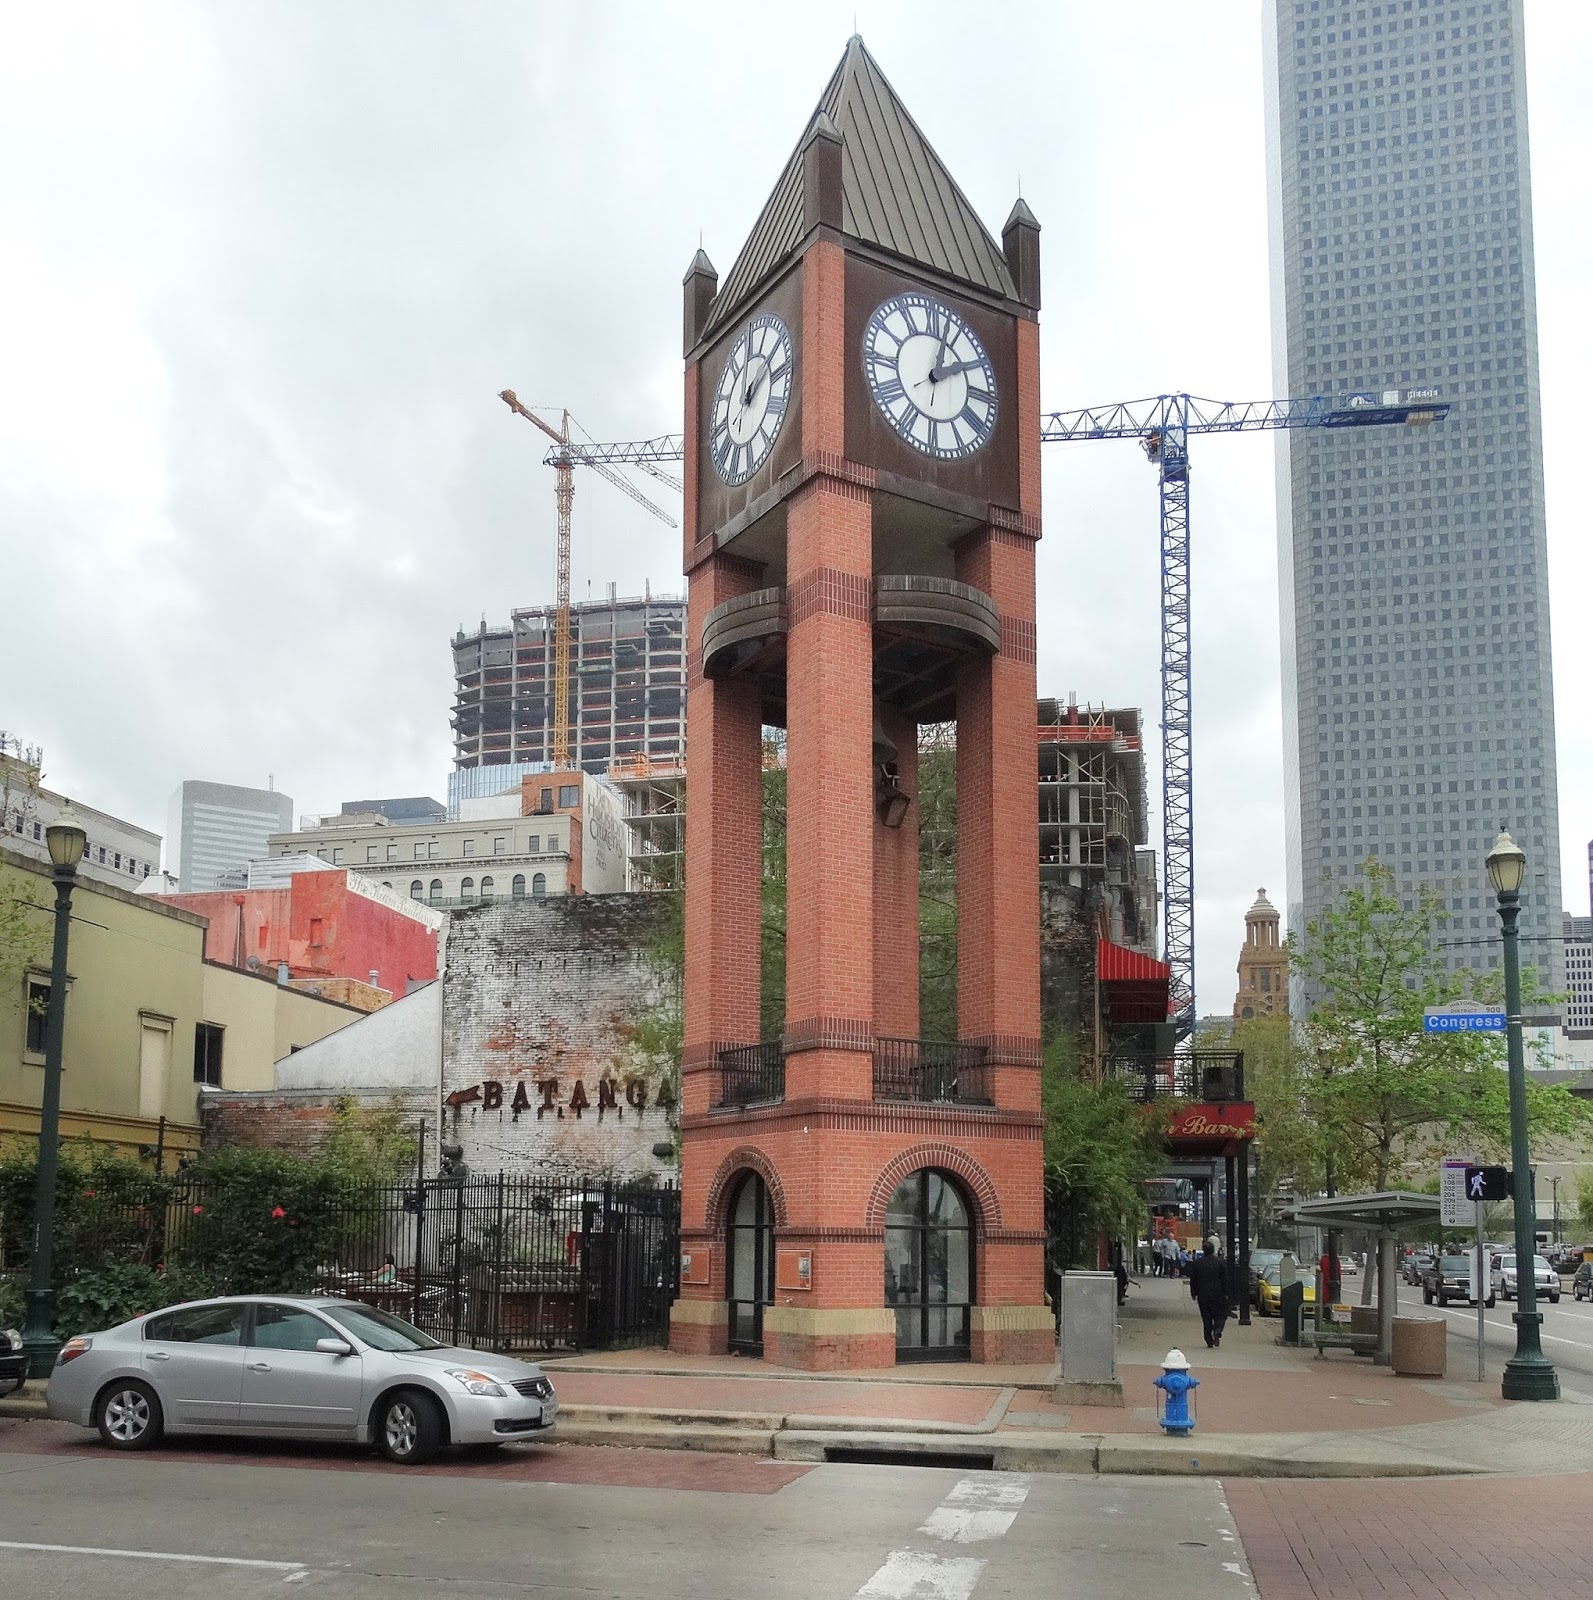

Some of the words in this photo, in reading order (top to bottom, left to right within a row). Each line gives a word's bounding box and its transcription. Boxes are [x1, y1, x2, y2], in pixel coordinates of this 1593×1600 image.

[1428, 1016, 1502, 1030] Congress
[482, 1078, 679, 1109] BATANGA
[1182, 1115, 1236, 1135] Bar
